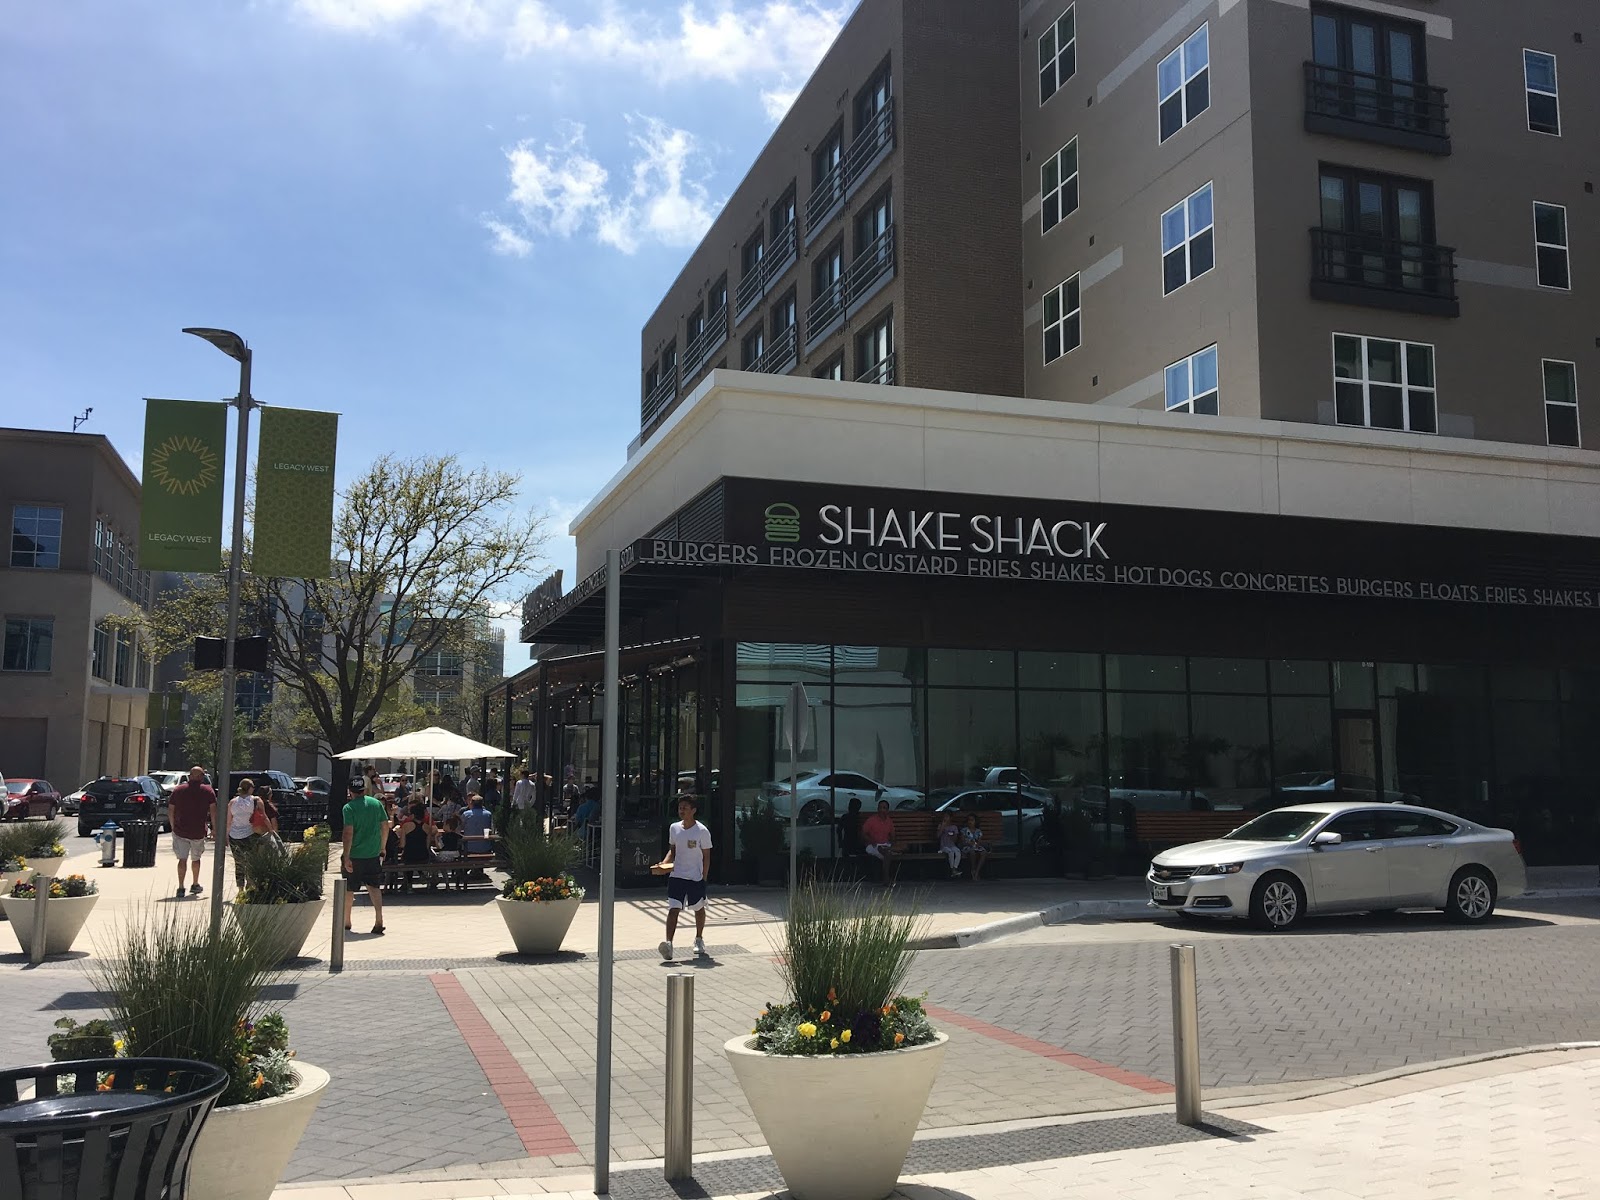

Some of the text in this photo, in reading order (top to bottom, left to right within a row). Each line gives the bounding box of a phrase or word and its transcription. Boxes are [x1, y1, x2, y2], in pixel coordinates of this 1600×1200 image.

[273, 462, 330, 473] LEGACY WEST
[148, 533, 213, 544] LEGACY WEST
[817, 503, 1110, 560] SHAKE SHACK
[620, 544, 635, 571] SODA
[652, 539, 760, 565] BURGERS
[769, 546, 858, 571] FROZEN
[862, 553, 958, 576] CUSTARD
[967, 557, 1022, 579] FRIES
[1030, 562, 1107, 583] SHAKES
[1114, 565, 1154, 586] HOT
[1158, 567, 1214, 588] DOGS
[1219, 571, 1330, 595] CONCRETES
[1336, 576, 1414, 599] BURGERS
[1420, 582, 1480, 602] FLOATS
[1485, 585, 1528, 605] FRIES
[1533, 588, 1592, 608] SHAKES
